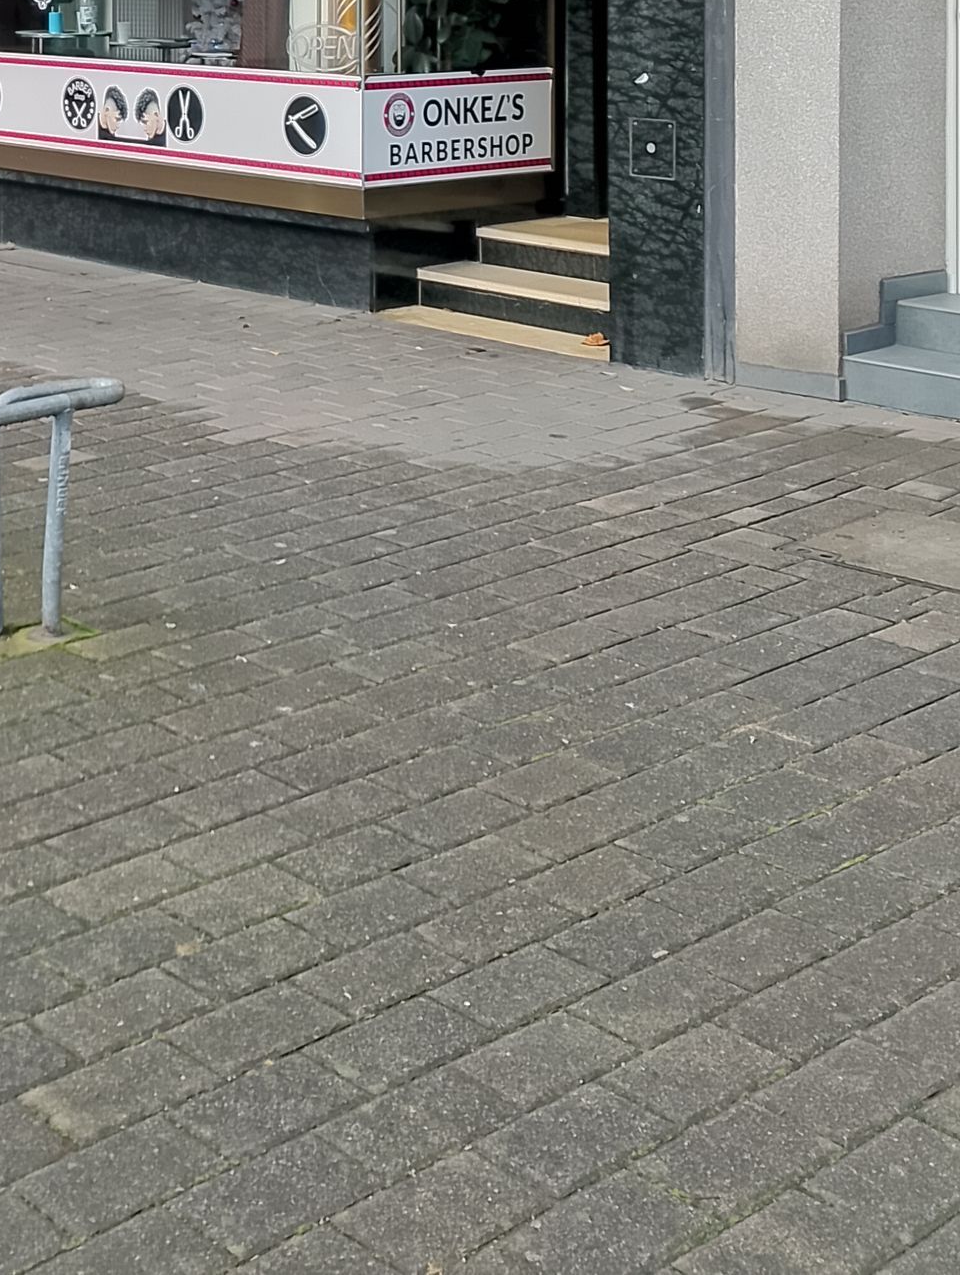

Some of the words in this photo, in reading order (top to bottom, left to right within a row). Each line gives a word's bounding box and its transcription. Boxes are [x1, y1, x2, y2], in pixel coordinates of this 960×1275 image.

[294, 34, 357, 61] OPEN
[67, 80, 93, 99] BARBER
[423, 93, 525, 127] ONKEL'S
[389, 133, 534, 167] BARBERSHOP
